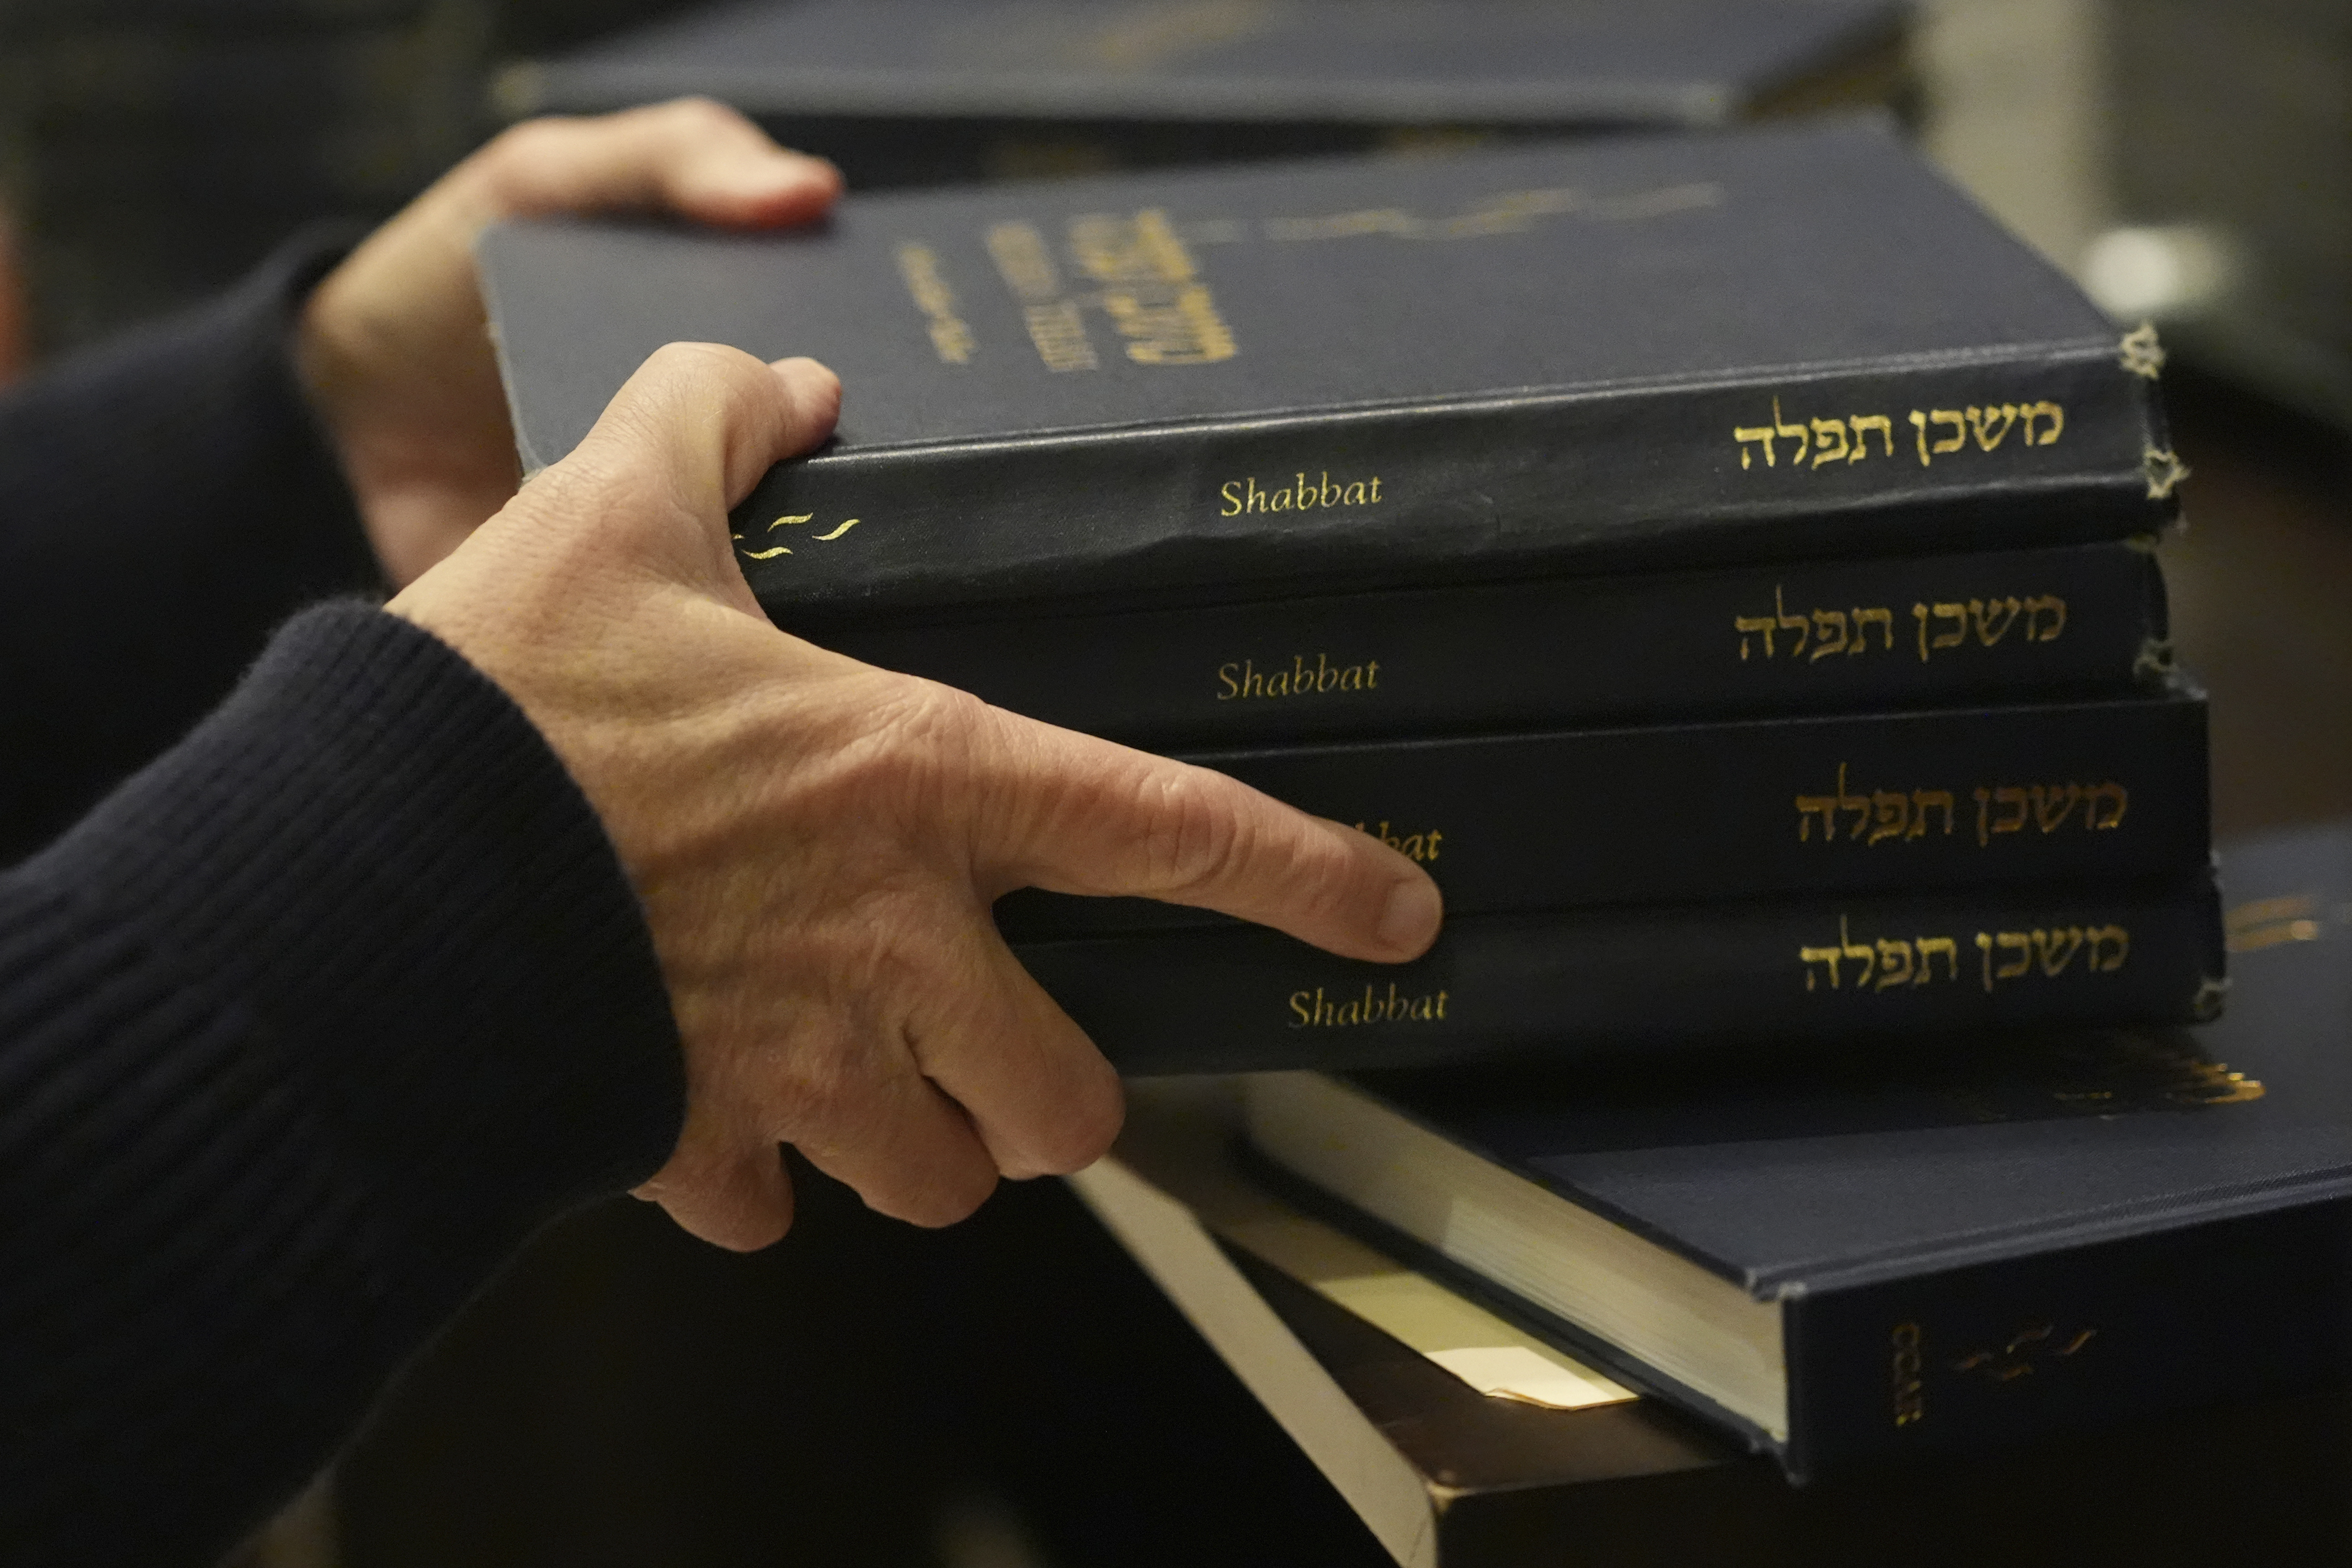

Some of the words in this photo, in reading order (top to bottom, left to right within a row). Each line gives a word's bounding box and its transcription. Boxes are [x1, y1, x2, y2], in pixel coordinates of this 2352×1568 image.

[1733, 395, 1895, 471] תפלה
[1908, 399, 2065, 467] משכן
[1220, 470, 1383, 518] Shabbat
[1734, 584, 1894, 662] תפלה
[1912, 594, 2068, 662] משכן
[1218, 651, 1379, 701] Shabbat
[1794, 761, 1956, 847] תפלה
[1975, 781, 2128, 848] משכן
[1799, 914, 1958, 994] תפלה
[1975, 924, 2130, 994] משכן
[1288, 983, 1449, 1029] Shabbat
